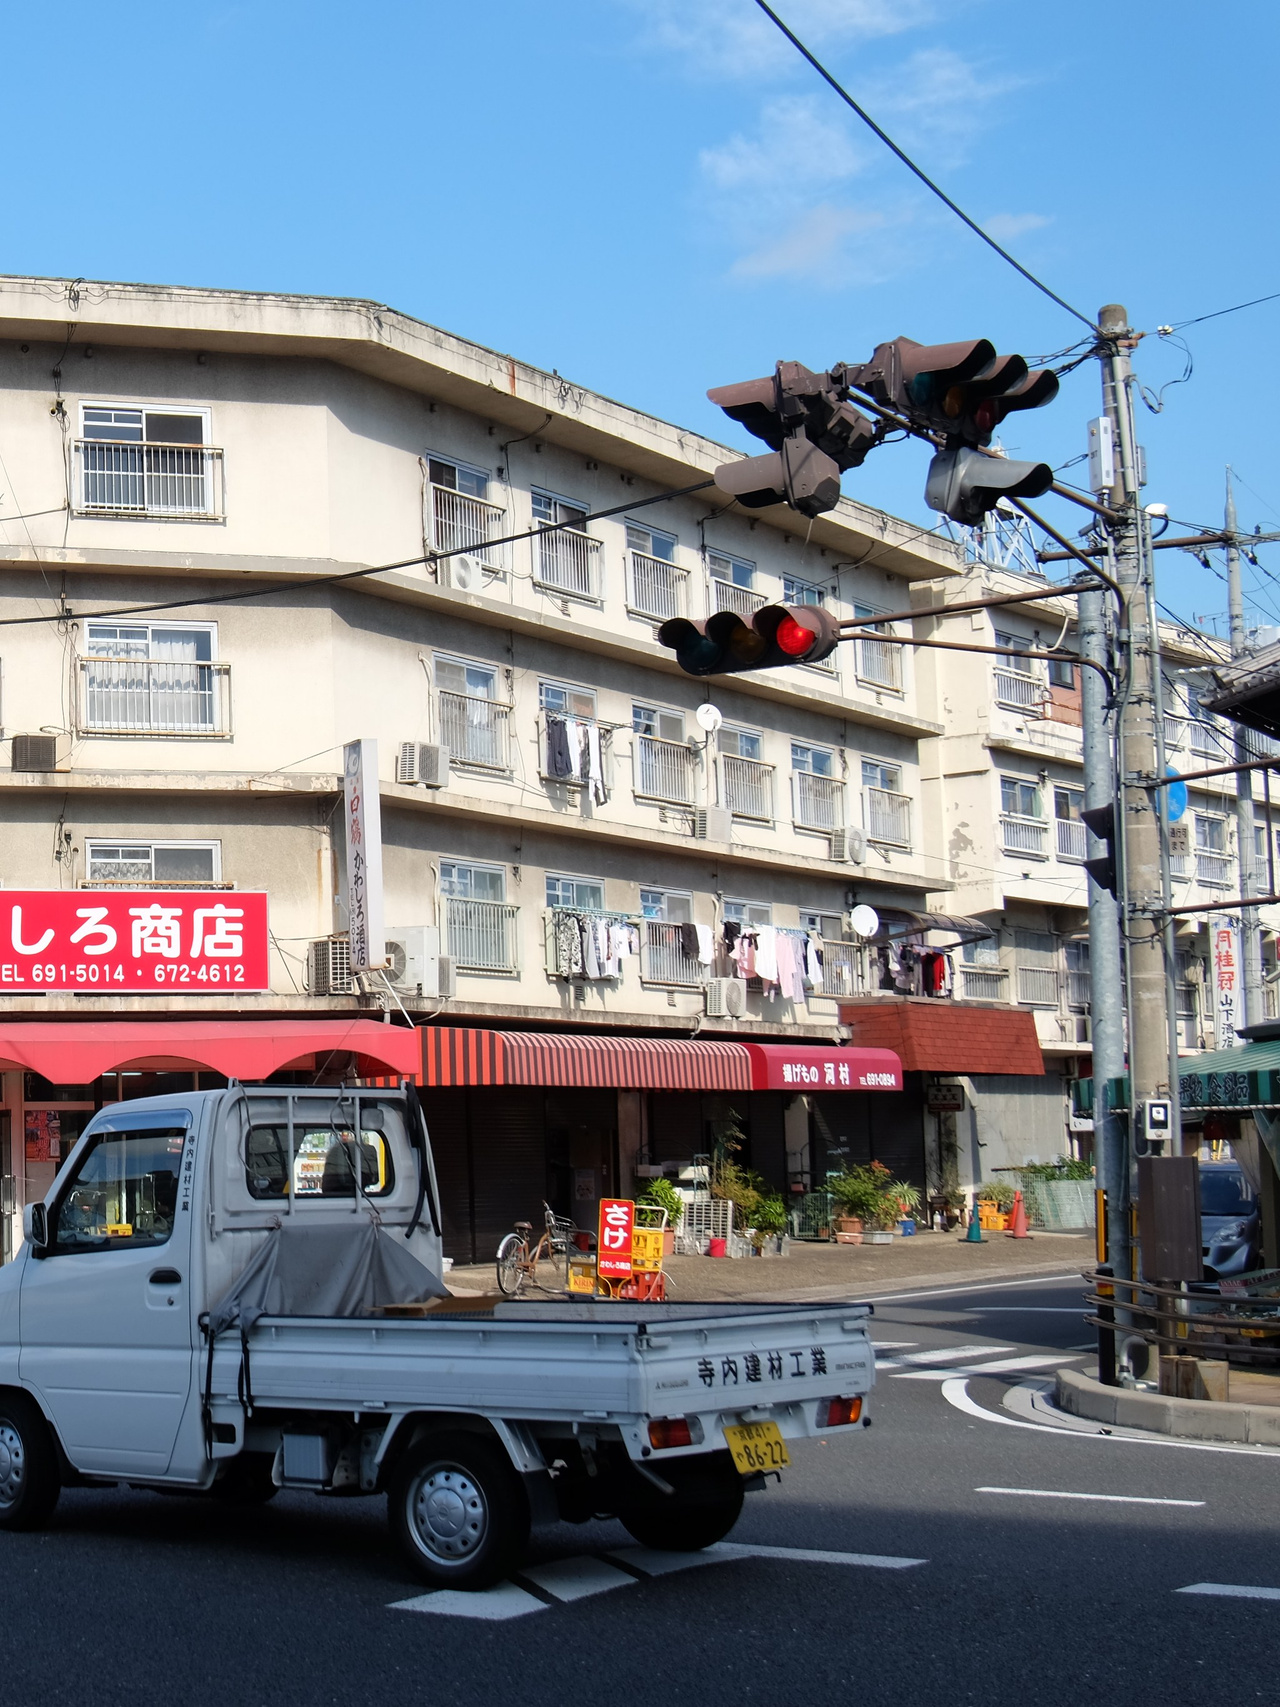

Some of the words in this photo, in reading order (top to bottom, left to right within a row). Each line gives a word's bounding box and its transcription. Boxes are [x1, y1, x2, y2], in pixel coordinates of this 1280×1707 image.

[32, 964, 125, 982] 691-5014
[154, 964, 245, 982] 672-4612
[1215, 930, 1234, 991] 月桂冠
[603, 1204, 629, 1249] さけ
[697, 1347, 828, 1388] 寺内建材工業
[743, 1440, 788, 1467] 86-22
